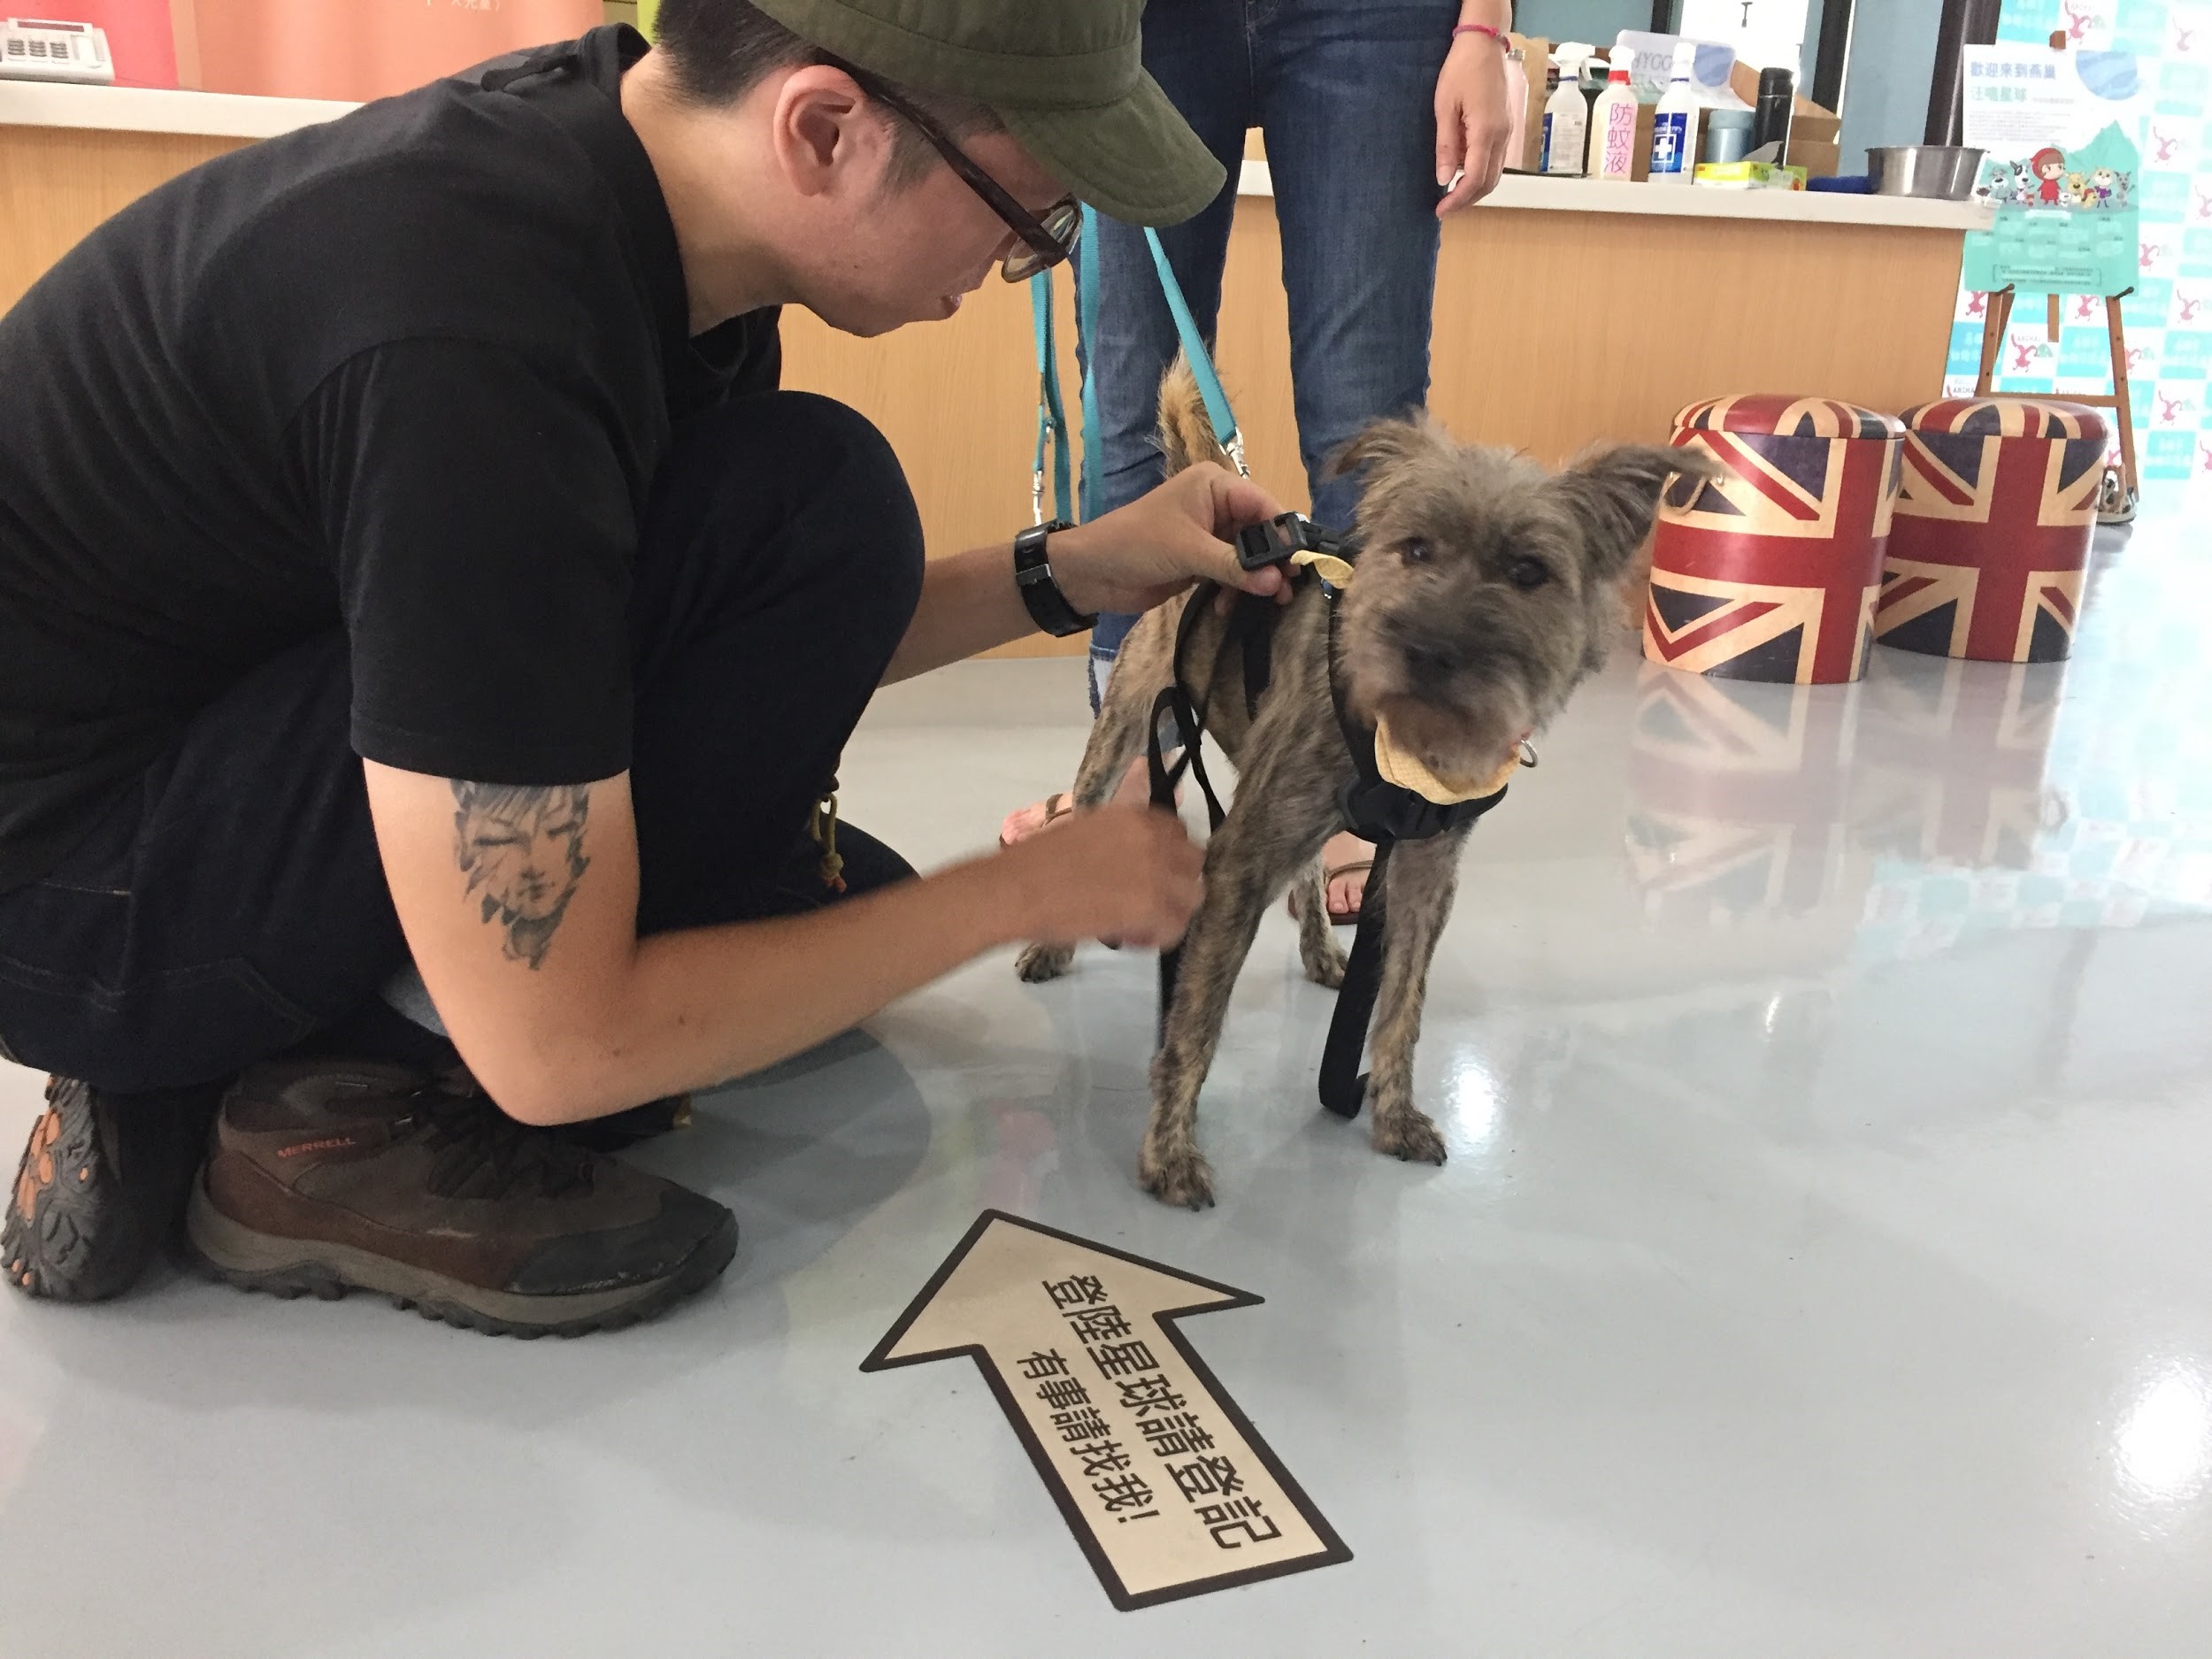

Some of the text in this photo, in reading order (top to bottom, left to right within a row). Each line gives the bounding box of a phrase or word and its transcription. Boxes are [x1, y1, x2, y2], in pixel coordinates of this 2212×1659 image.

[1603, 103, 1633, 174] 防蚊液
[278, 1138, 357, 1158] MERRELL
[1017, 1349, 1160, 1523] 有事請找我!
[1042, 1275, 1281, 1548] 登陸星球請登記
